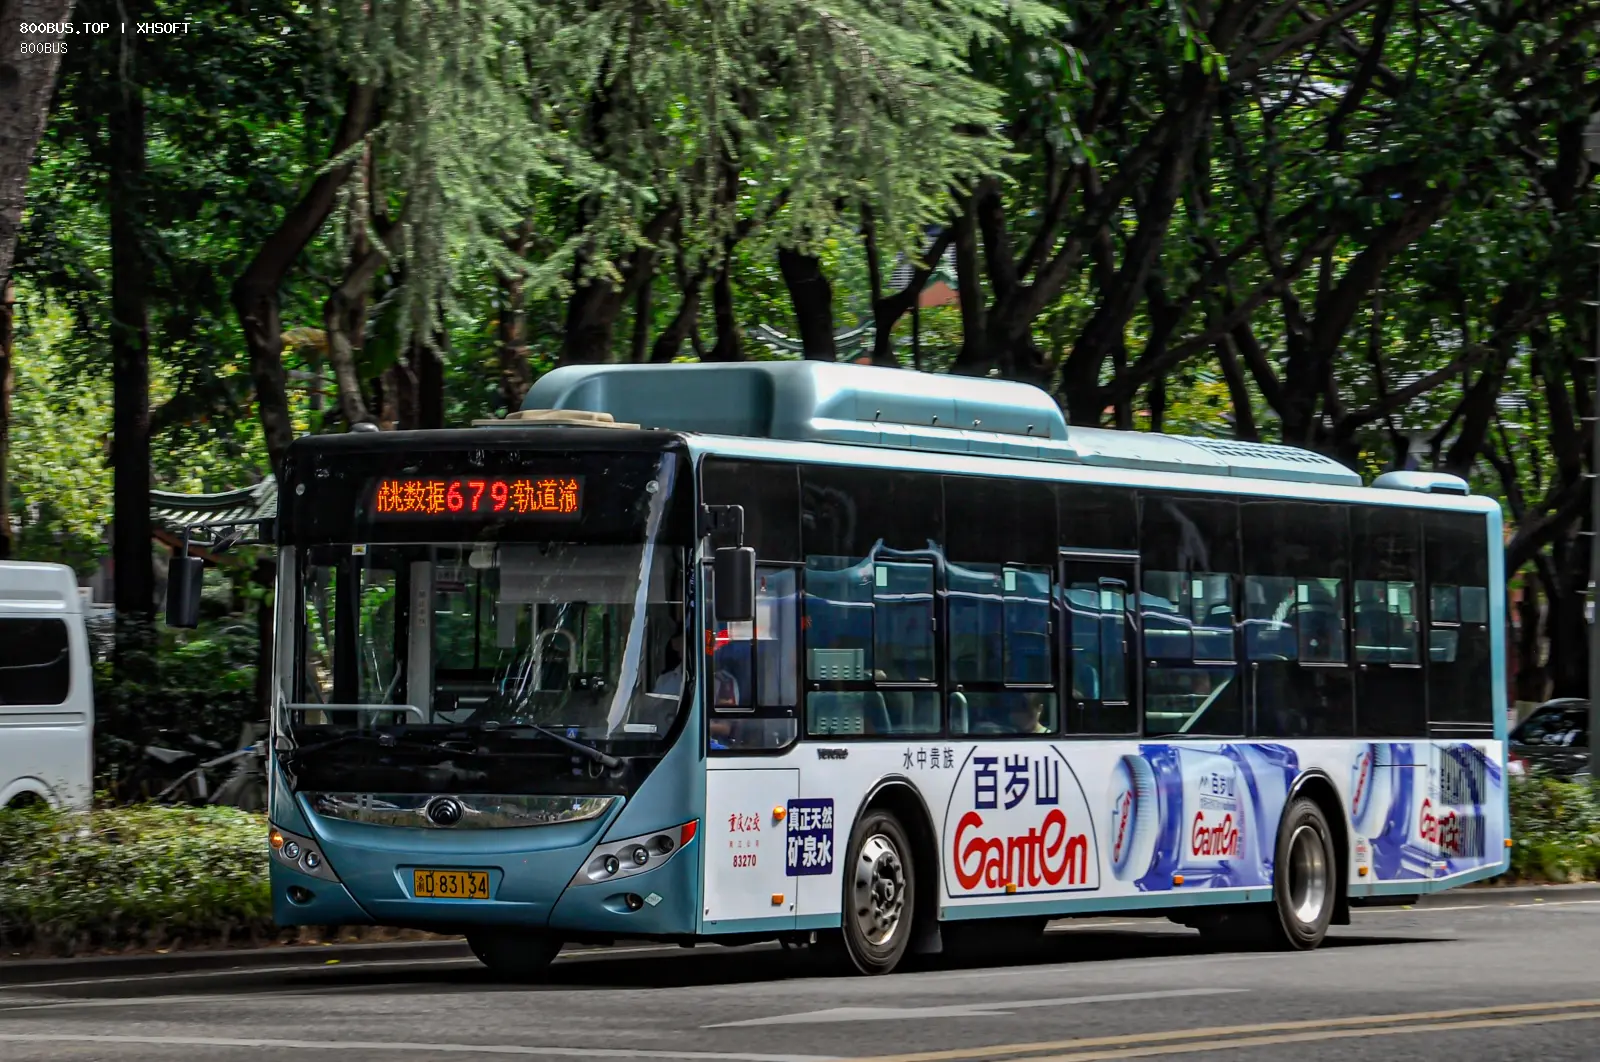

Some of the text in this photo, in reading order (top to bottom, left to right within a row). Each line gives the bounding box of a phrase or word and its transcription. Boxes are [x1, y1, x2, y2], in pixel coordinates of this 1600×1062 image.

[447, 481, 508, 511] 679
[903, 747, 954, 770] 水中贵族
[973, 754, 1059, 810] 百岁山
[728, 812, 761, 832] 重庆公交
[788, 806, 833, 832] 真正天然
[1192, 811, 1239, 856] Ganten
[733, 854, 757, 867] 83270
[787, 834, 832, 868] 矿泉水
[953, 808, 1088, 890] Ganten
